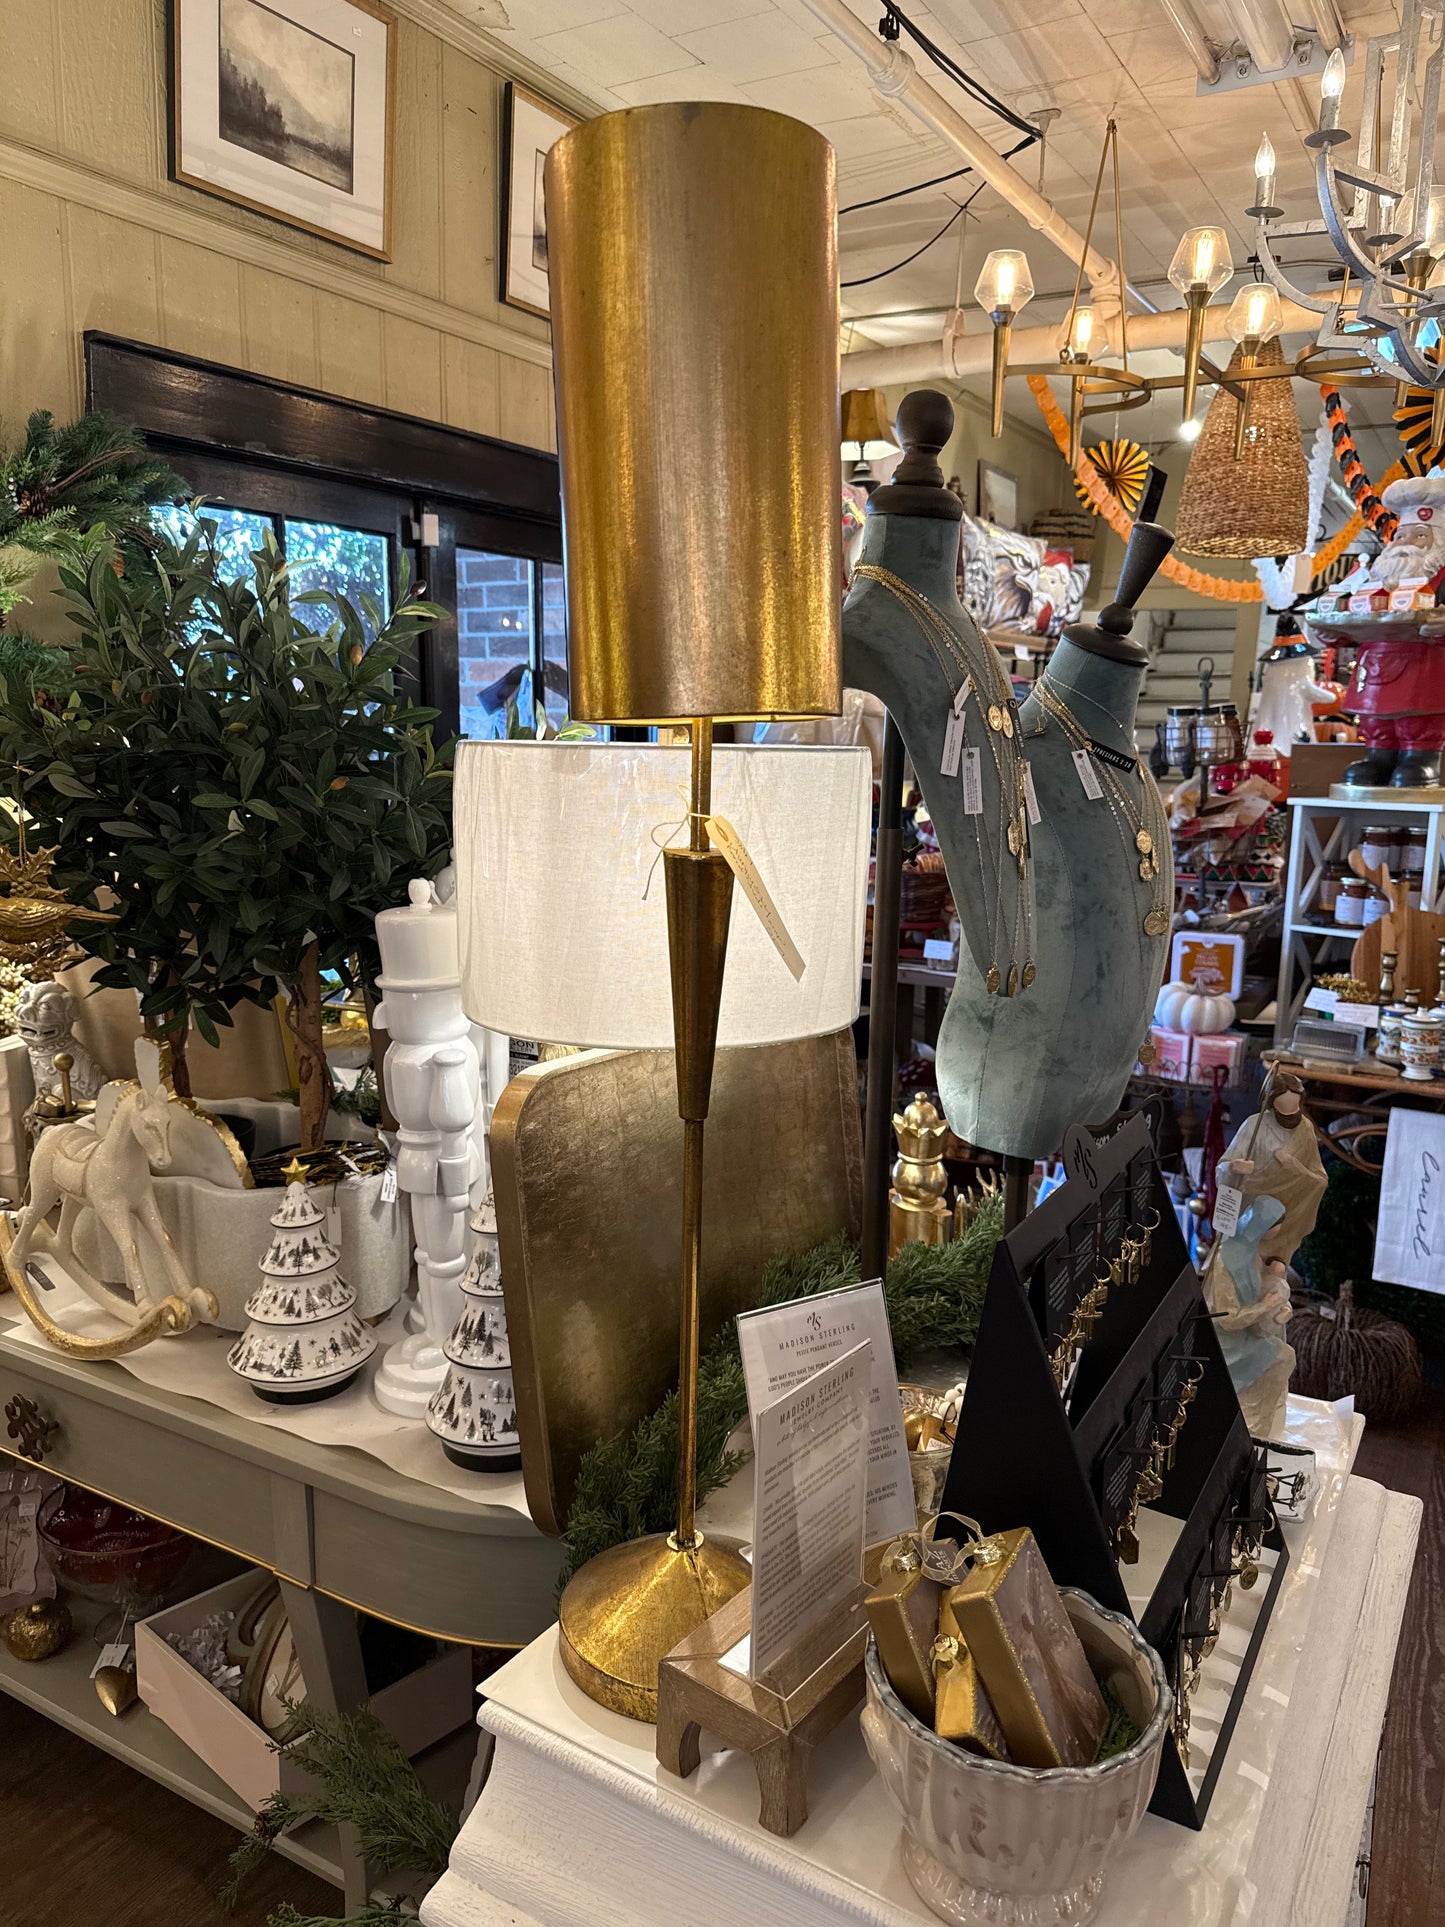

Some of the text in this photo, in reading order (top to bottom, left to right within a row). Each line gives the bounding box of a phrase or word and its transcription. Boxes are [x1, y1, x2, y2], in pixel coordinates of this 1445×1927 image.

[779, 1323, 856, 1350] MADISON STERLING
[810, 1343, 827, 1353] PENDANT
[779, 1364, 854, 1426] MADISON STERLING
[791, 1404, 814, 1426] JEWELRY
[816, 1384, 843, 1409] COMPANY
